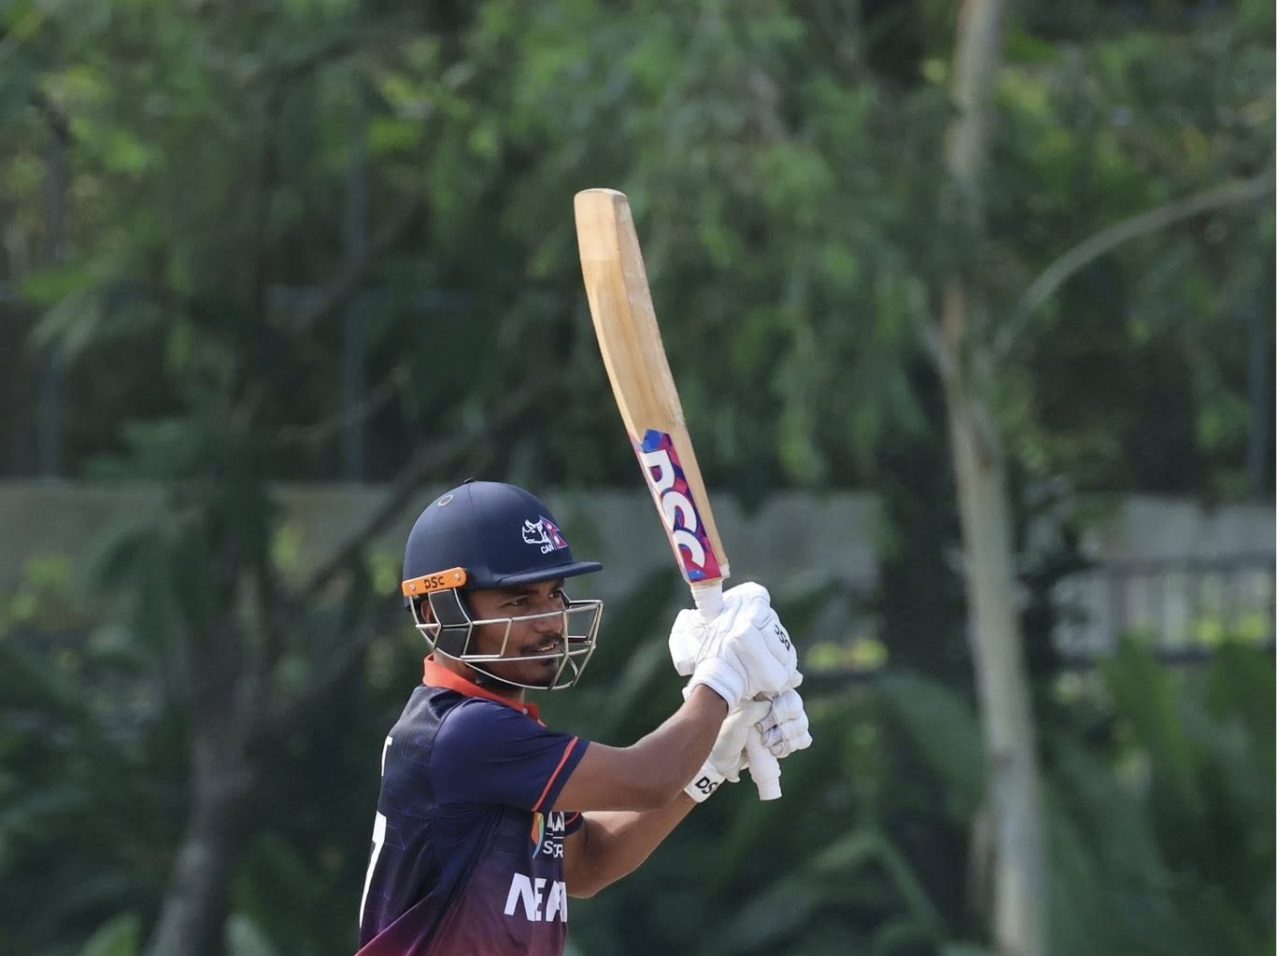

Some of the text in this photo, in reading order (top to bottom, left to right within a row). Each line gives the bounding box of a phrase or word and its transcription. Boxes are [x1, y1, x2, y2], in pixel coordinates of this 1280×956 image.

[639, 449, 706, 568] DSC
[423, 576, 445, 589] DSC
[694, 775, 719, 795] DS
